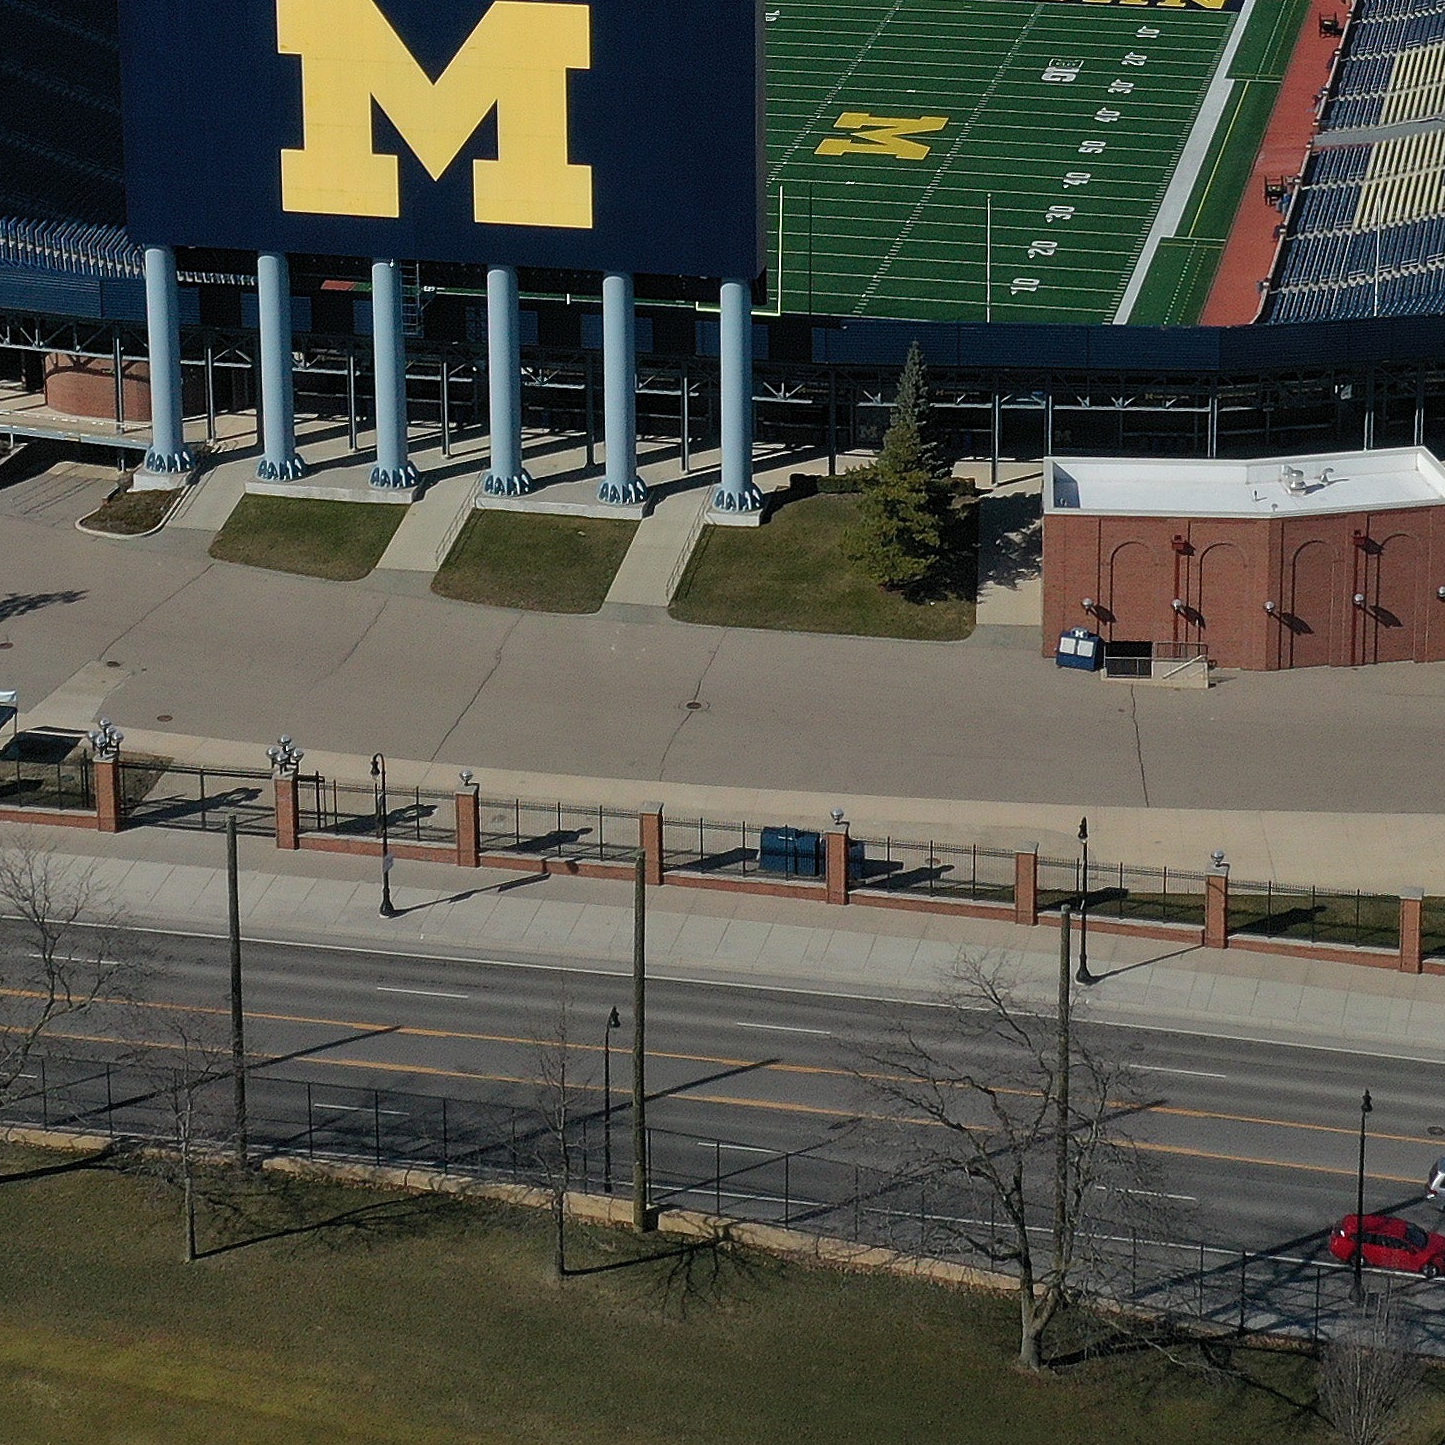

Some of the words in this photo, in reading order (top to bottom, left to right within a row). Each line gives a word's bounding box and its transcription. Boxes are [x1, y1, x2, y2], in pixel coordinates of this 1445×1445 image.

[1135, 28, 1160, 39] 10
[1121, 53, 1148, 66] 20
[1107, 81, 1135, 94] 30
[1094, 109, 1121, 122] 40
[813, 111, 950, 161] M
[1078, 140, 1106, 154] 50
[1063, 172, 1091, 185] 40
[1045, 205, 1075, 220] 30
[1027, 241, 1058, 256] 20
[1010, 277, 1040, 292] 10
